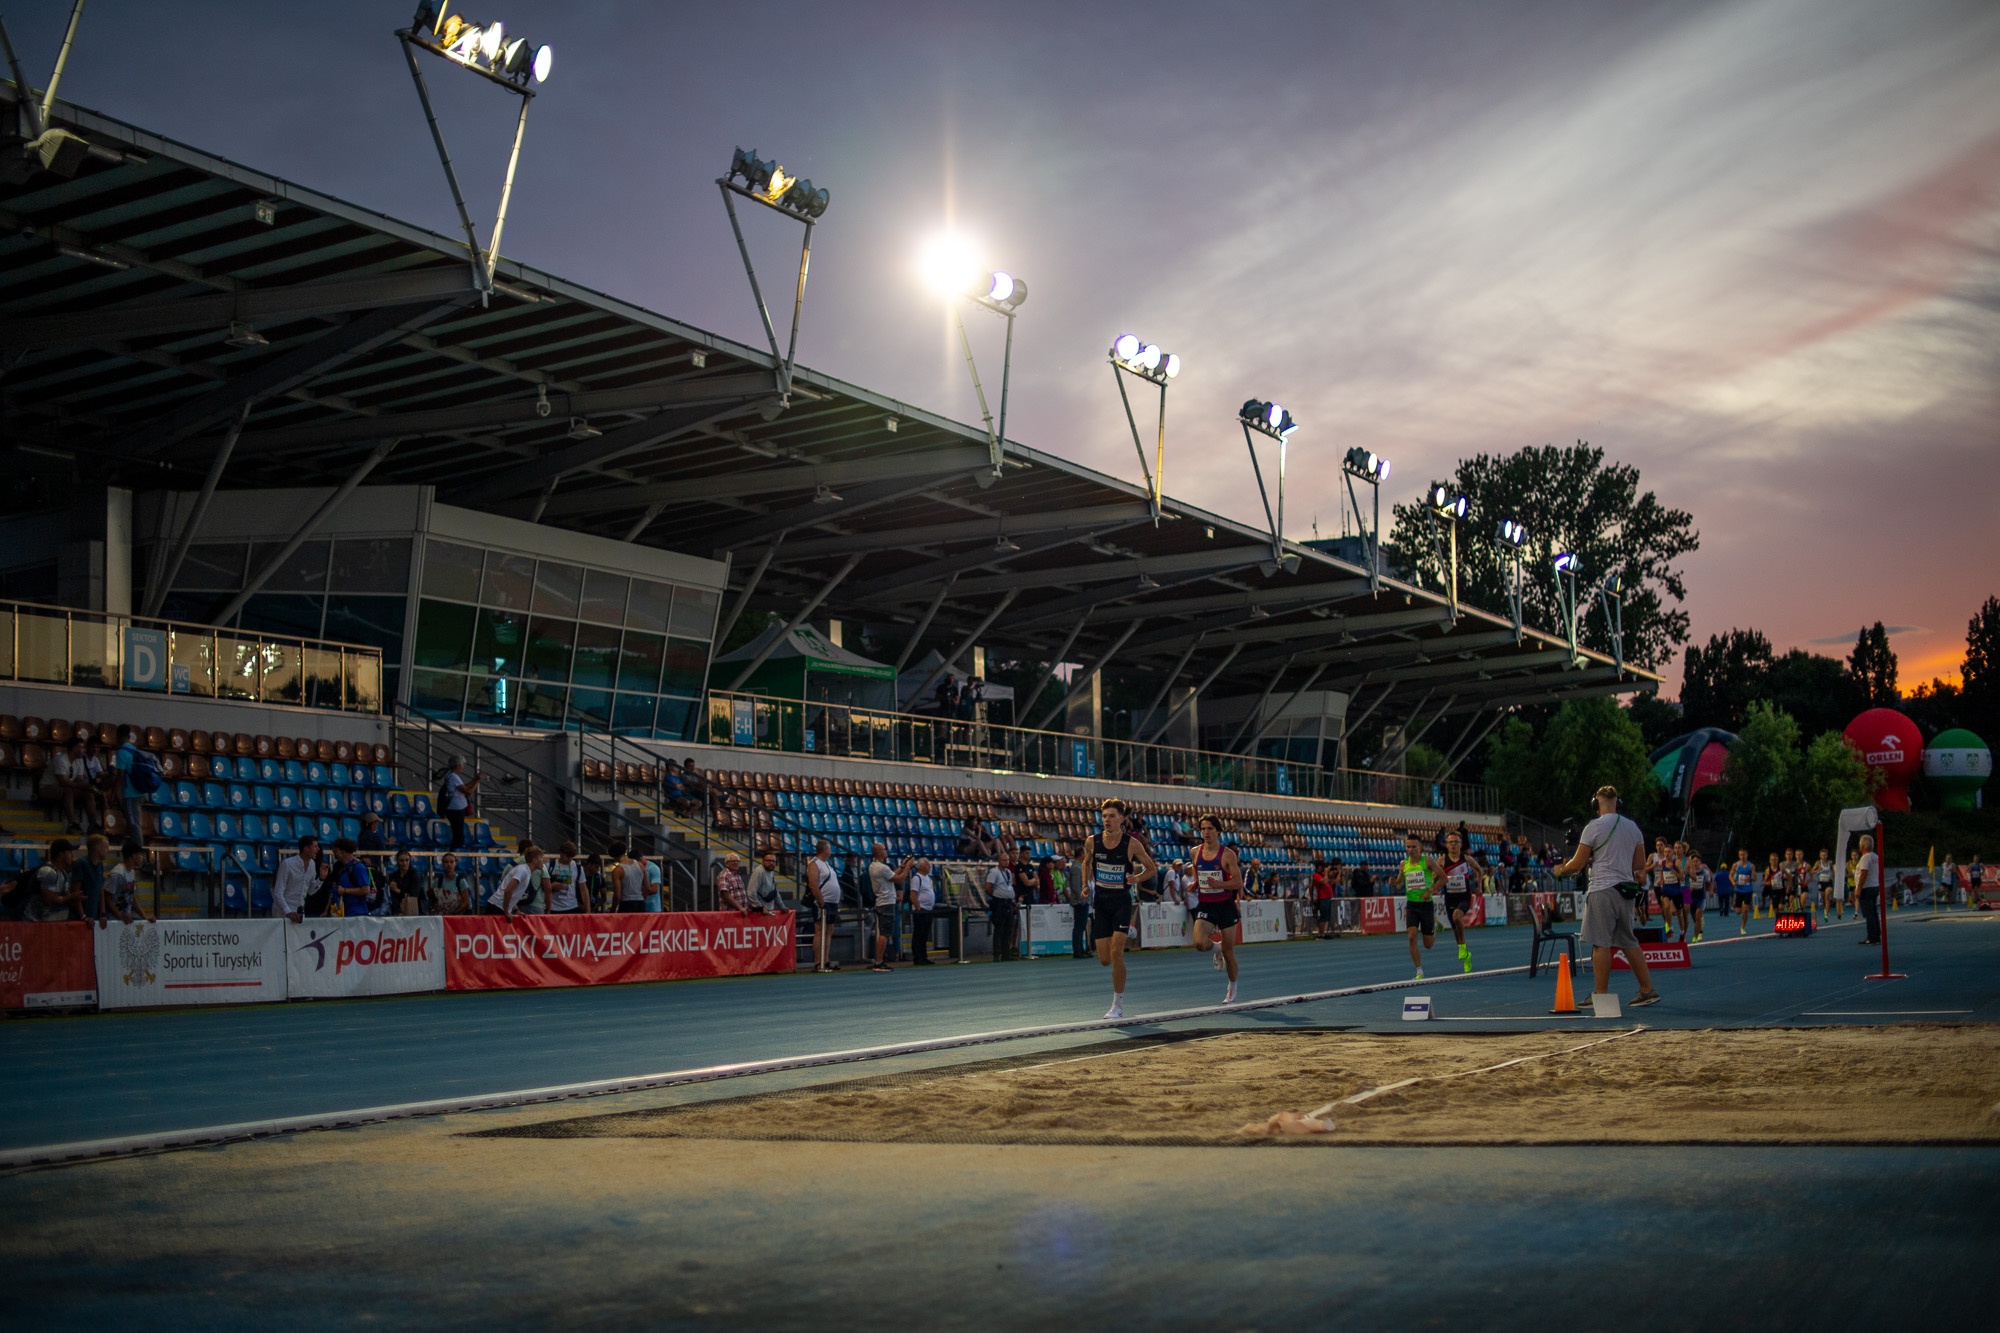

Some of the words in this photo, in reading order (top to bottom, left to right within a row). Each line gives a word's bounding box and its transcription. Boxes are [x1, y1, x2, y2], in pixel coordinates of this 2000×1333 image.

[131, 633, 158, 643] SEKTOR
[133, 644, 157, 683] D
[173, 668, 189, 681] WC
[735, 716, 753, 736] E-H
[1077, 751, 1083, 773] F
[1868, 751, 1902, 763] ORLEN
[1279, 773, 1286, 792] G
[1098, 872, 1122, 881] HERZYK
[1364, 898, 1390, 919] PZLA
[163, 930, 240, 946] Ministerstwo
[455, 933, 537, 960] POLSKI
[541, 931, 637, 962] ZWIĄZEK
[638, 928, 709, 954] LEKKIEJ
[713, 925, 788, 950] ATLETYKI
[335, 927, 429, 976] polanik
[1644, 951, 1682, 961] ORLEN
[163, 952, 203, 972] Sportu
[205, 952, 209, 968] i
[211, 951, 262, 971] Turystyki
